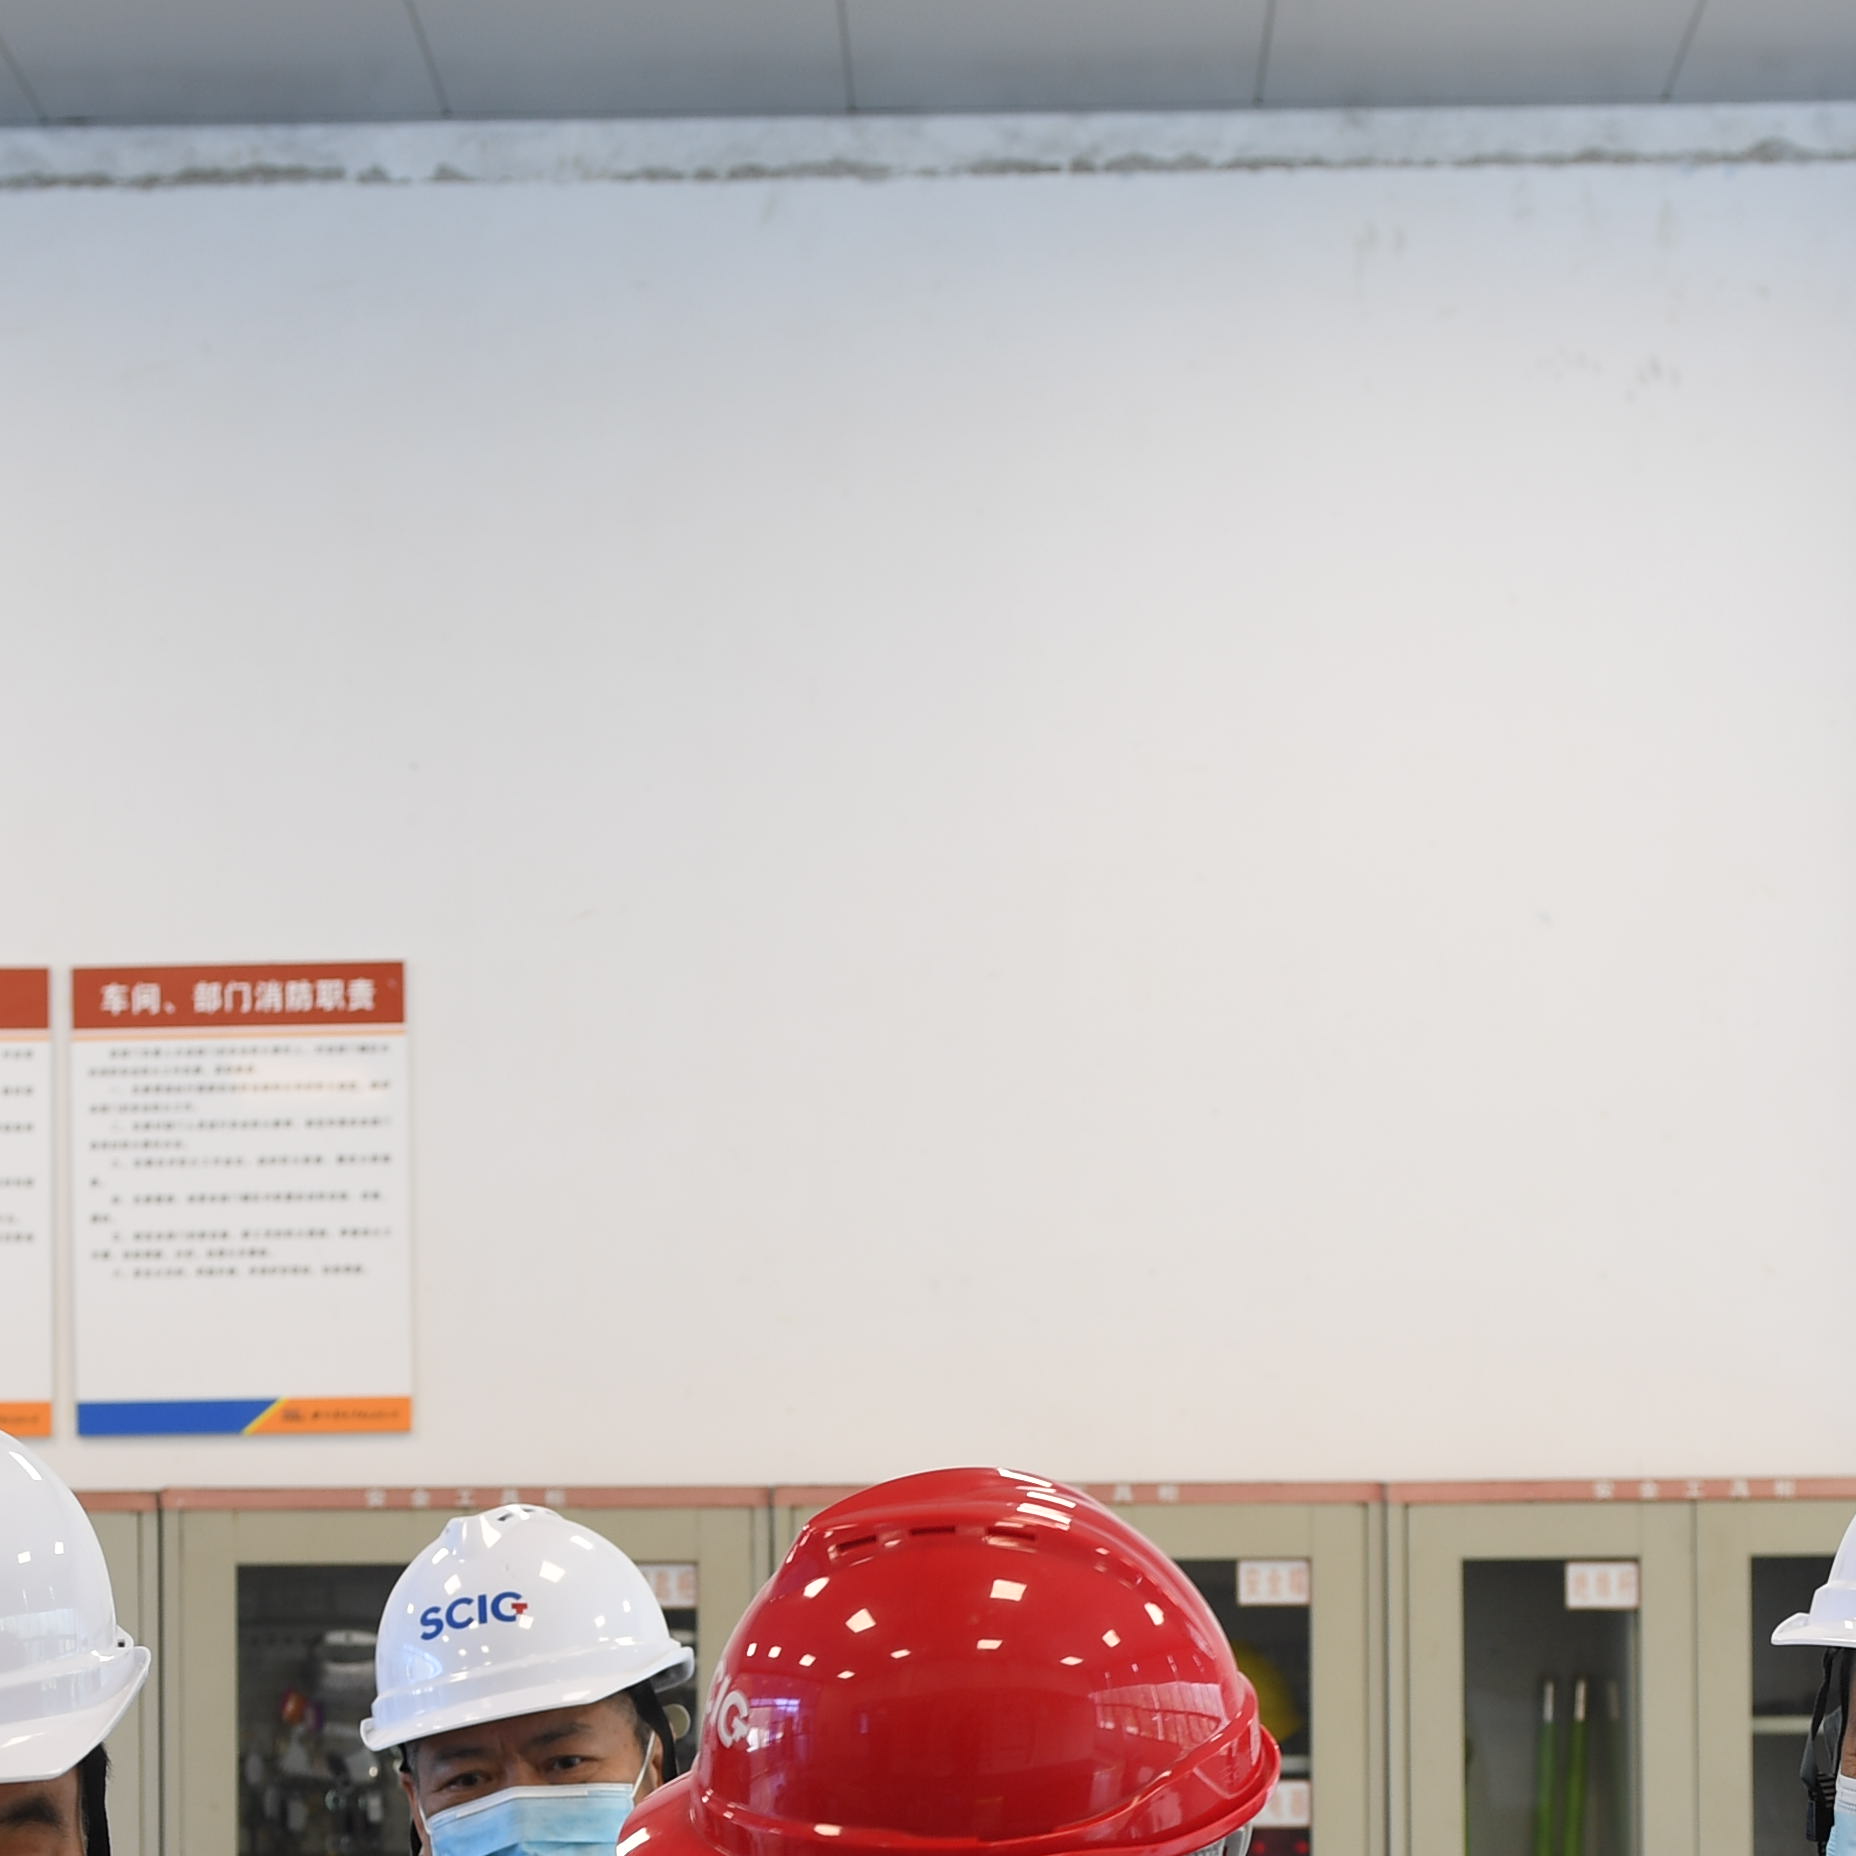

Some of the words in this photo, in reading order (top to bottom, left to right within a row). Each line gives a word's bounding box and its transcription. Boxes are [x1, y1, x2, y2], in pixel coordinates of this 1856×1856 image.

[100, 978, 376, 1016] 车间、部门消防职责
[420, 1591, 528, 1640] SCIG
